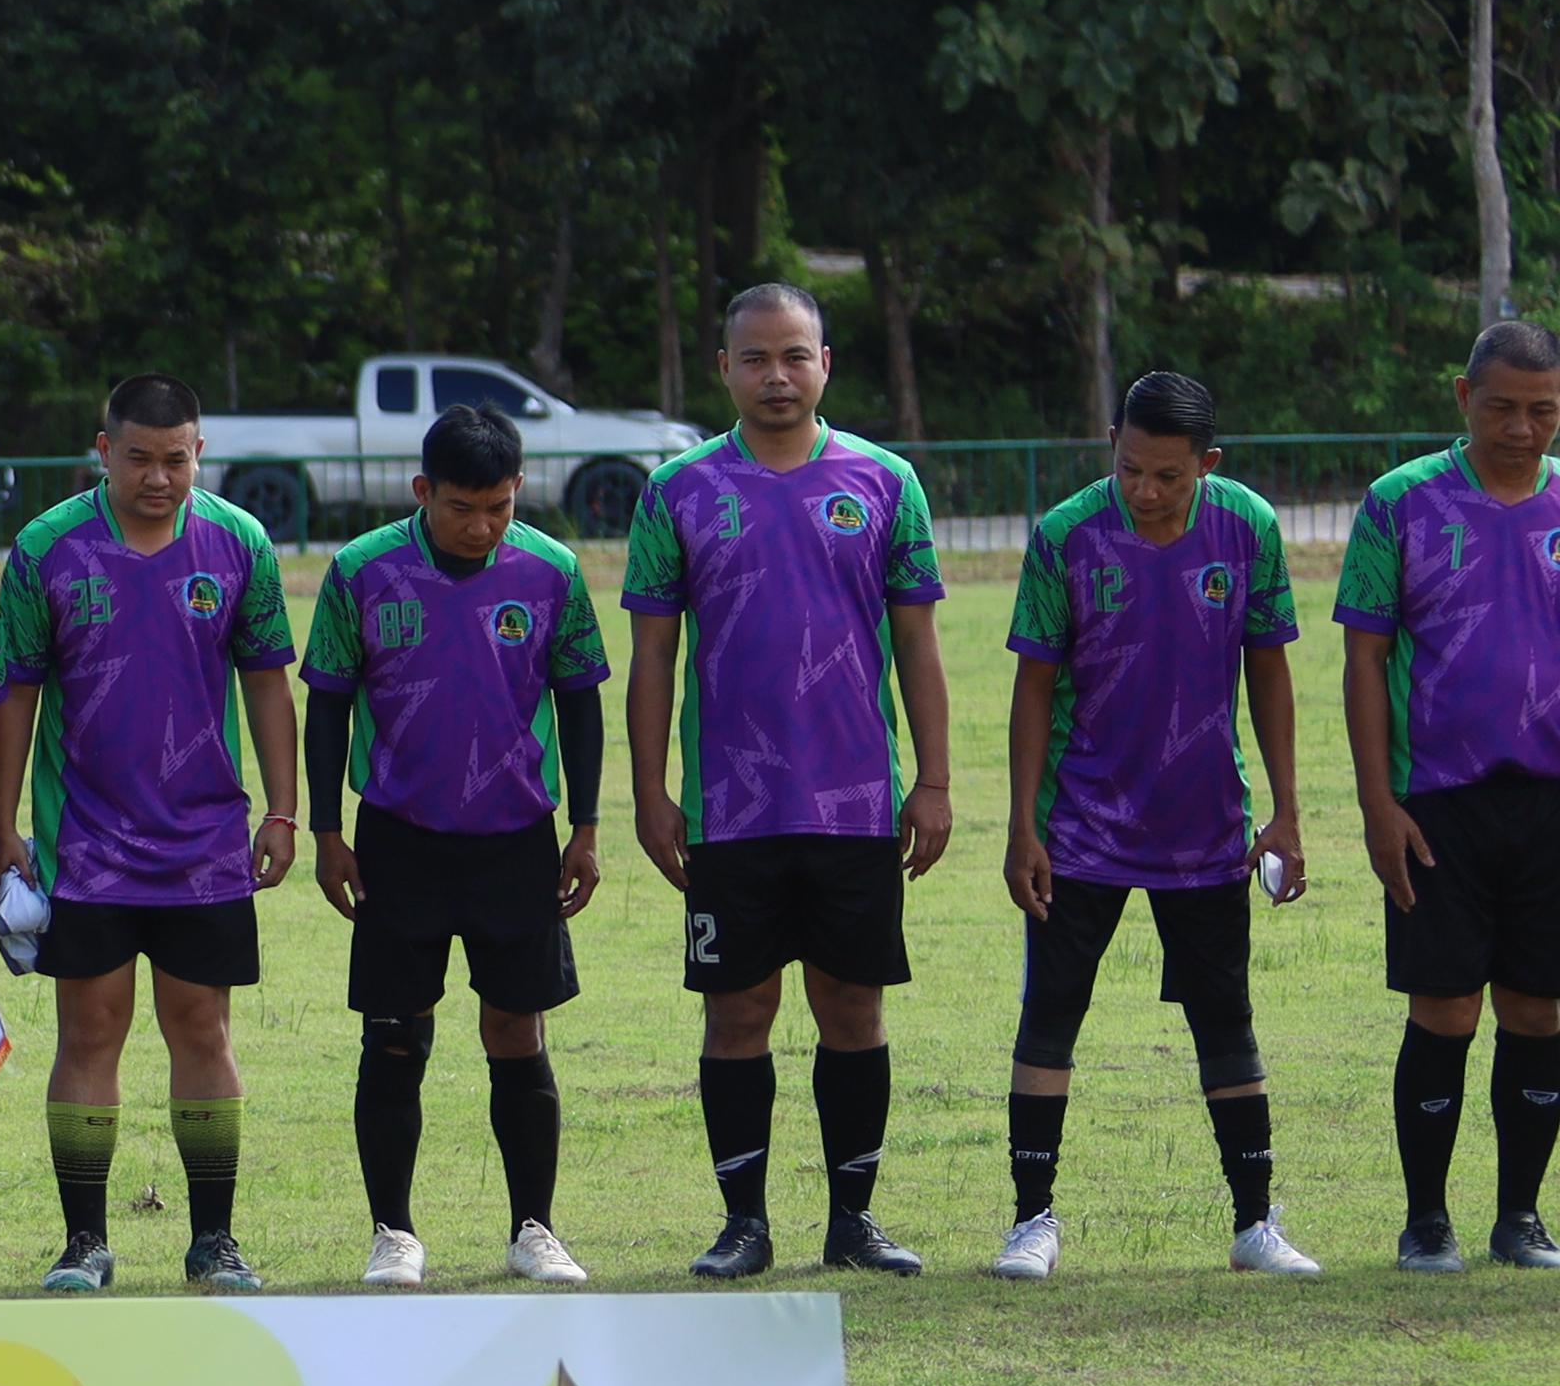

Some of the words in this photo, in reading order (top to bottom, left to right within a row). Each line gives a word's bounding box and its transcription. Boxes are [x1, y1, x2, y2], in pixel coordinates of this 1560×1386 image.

[715, 494, 741, 539] 3
[1441, 524, 1465, 570] 7
[70, 576, 114, 625] 35
[1091, 567, 1125, 614] 12
[378, 601, 423, 648] 89
